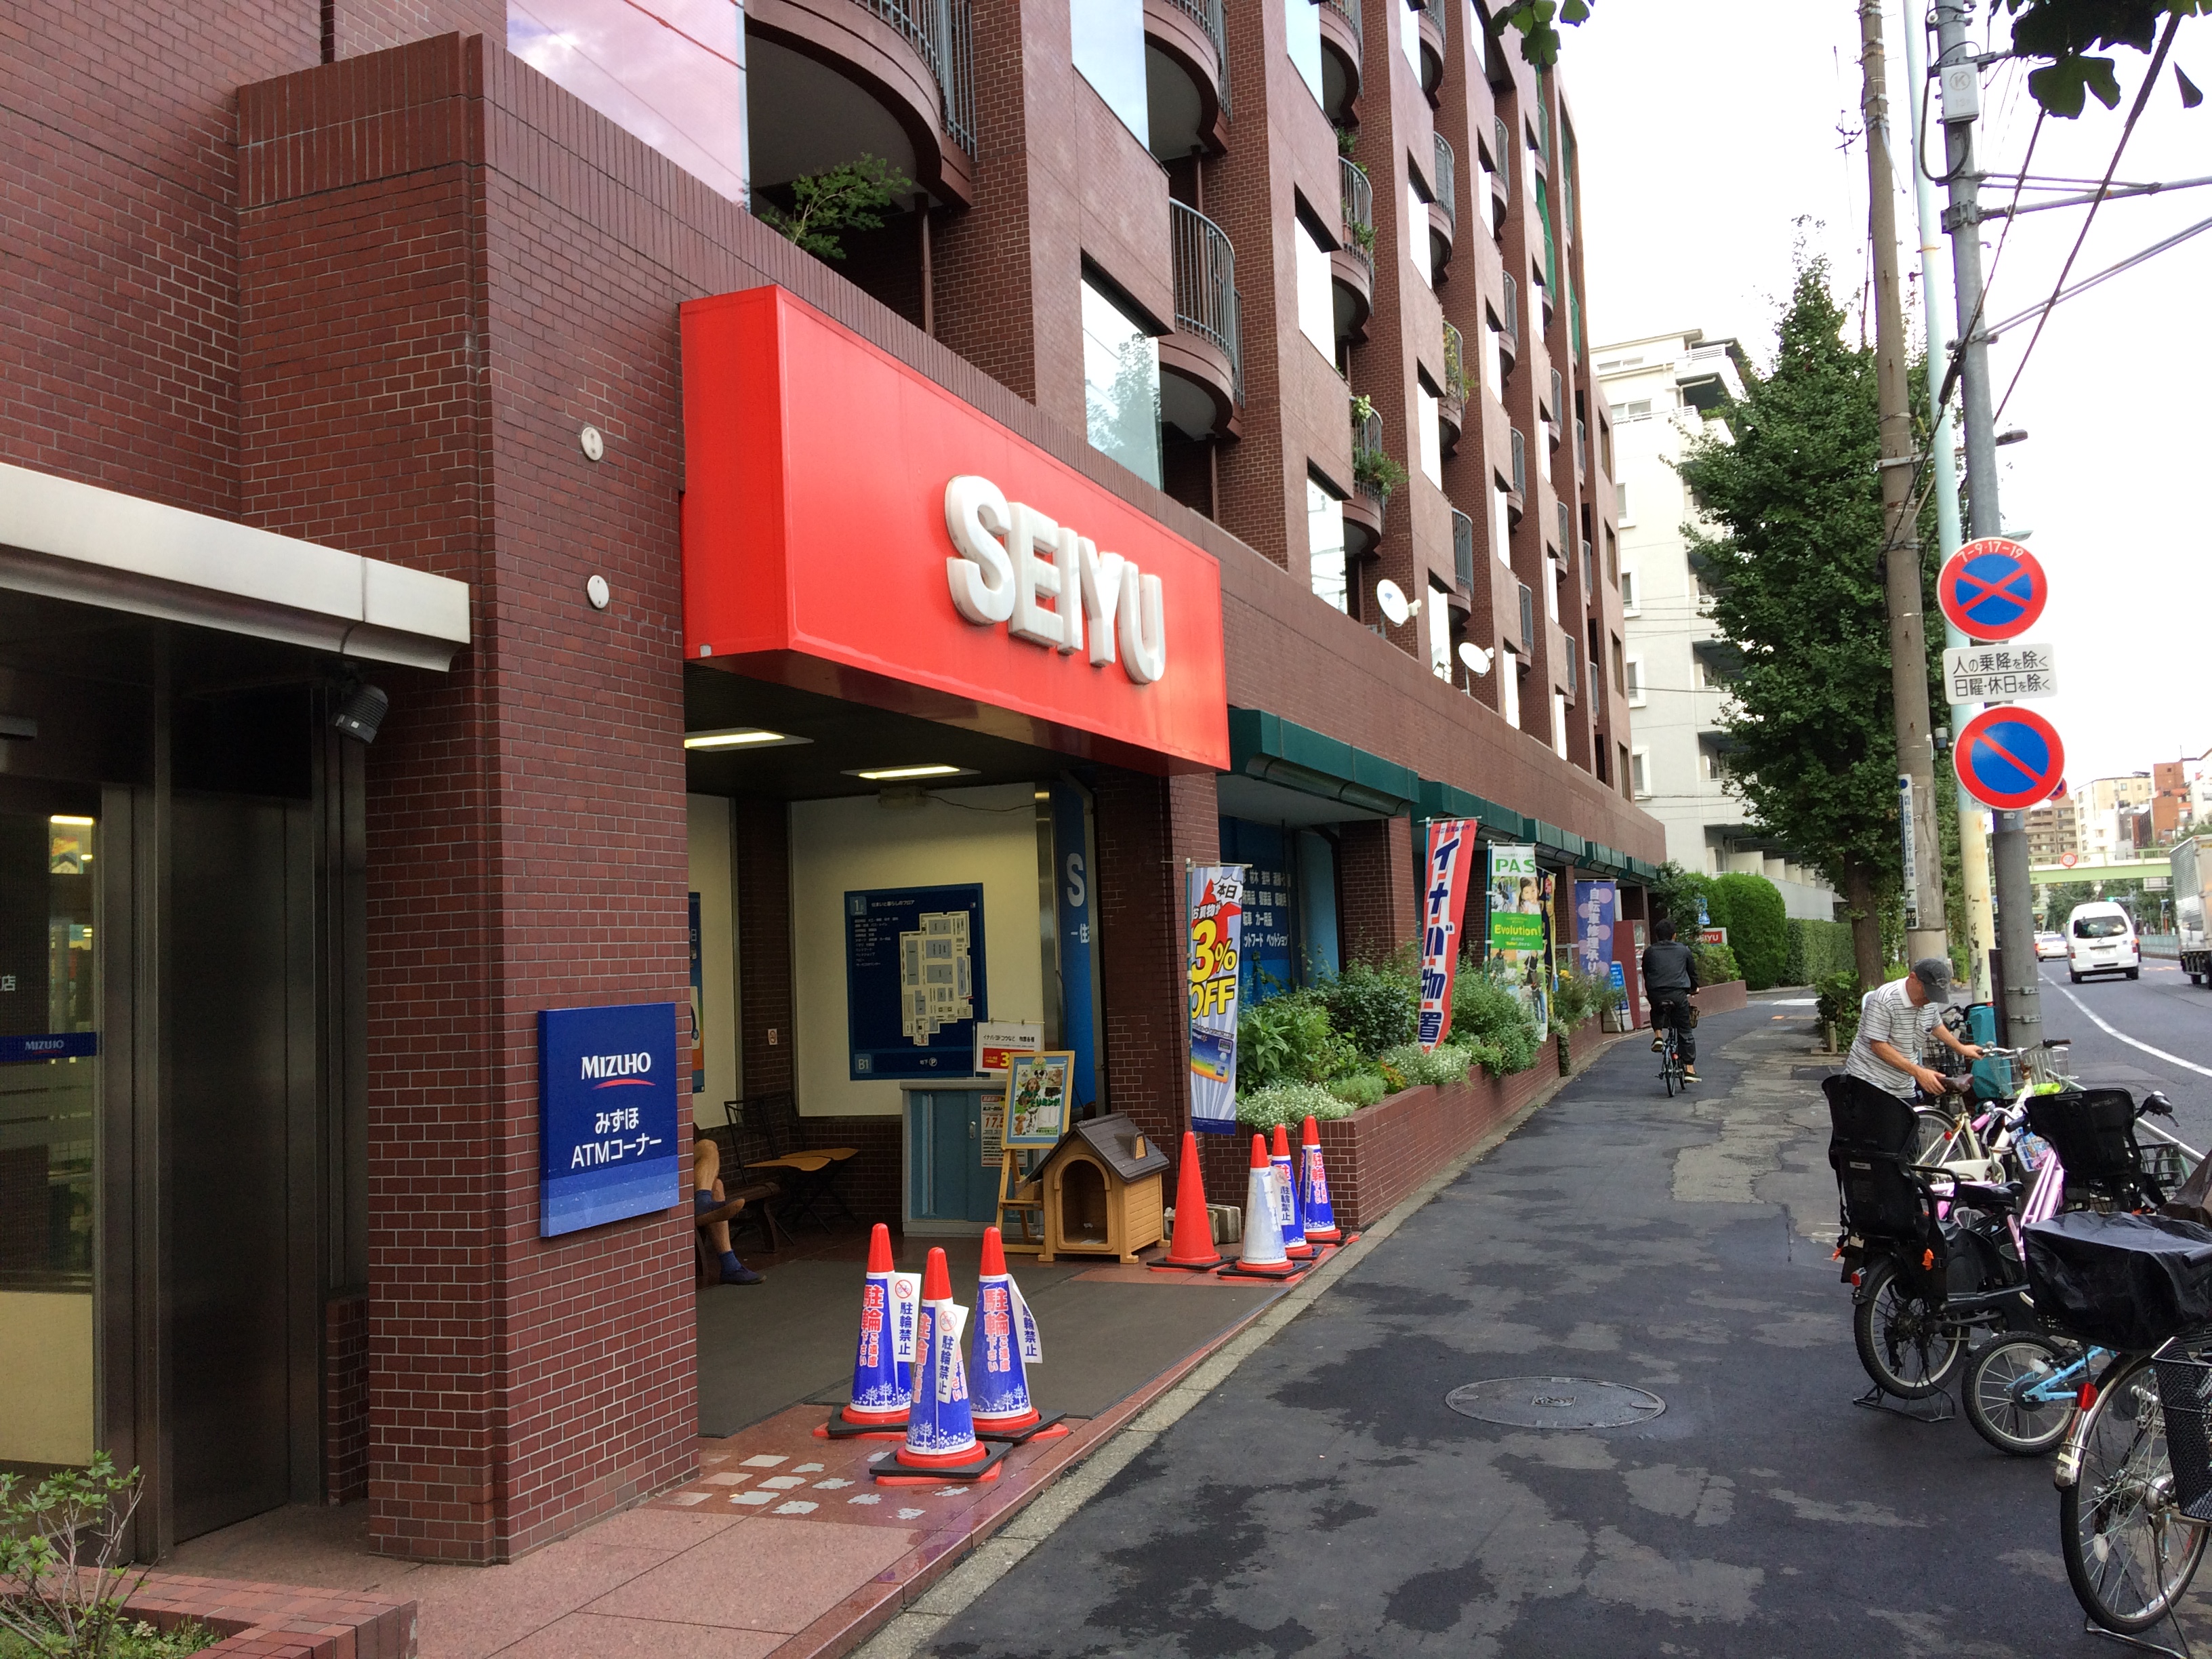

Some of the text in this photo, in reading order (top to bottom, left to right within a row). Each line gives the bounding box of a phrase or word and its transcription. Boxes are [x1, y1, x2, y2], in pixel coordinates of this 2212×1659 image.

[945, 474, 1166, 684] SEIYU
[1952, 651, 2048, 676] 人の乗降を除く
[1955, 673, 2051, 697] 日曜・休日を除く
[1495, 859, 1536, 874] PAS
[1216, 883, 1237, 899] 本日
[1418, 838, 1460, 1044] イナバ物置
[1494, 924, 1541, 937] Evolution!
[1192, 919, 1237, 983] 3%
[1191, 977, 1236, 1019] OFF
[581, 1052, 651, 1080] MIZUHO
[858, 1059, 869, 1069] B1
[595, 1107, 639, 1134] みずほ
[571, 1132, 662, 1169] ATMコーナー
[861, 1284, 884, 1334] 駐輪
[982, 1288, 1010, 1336] 駐輪
[899, 1302, 913, 1356] 駐輪禁止
[939, 1335, 955, 1395] 駐輪禁止
[986, 1336, 999, 1372] 下さい
[999, 1336, 1011, 1372] ご遠慮
